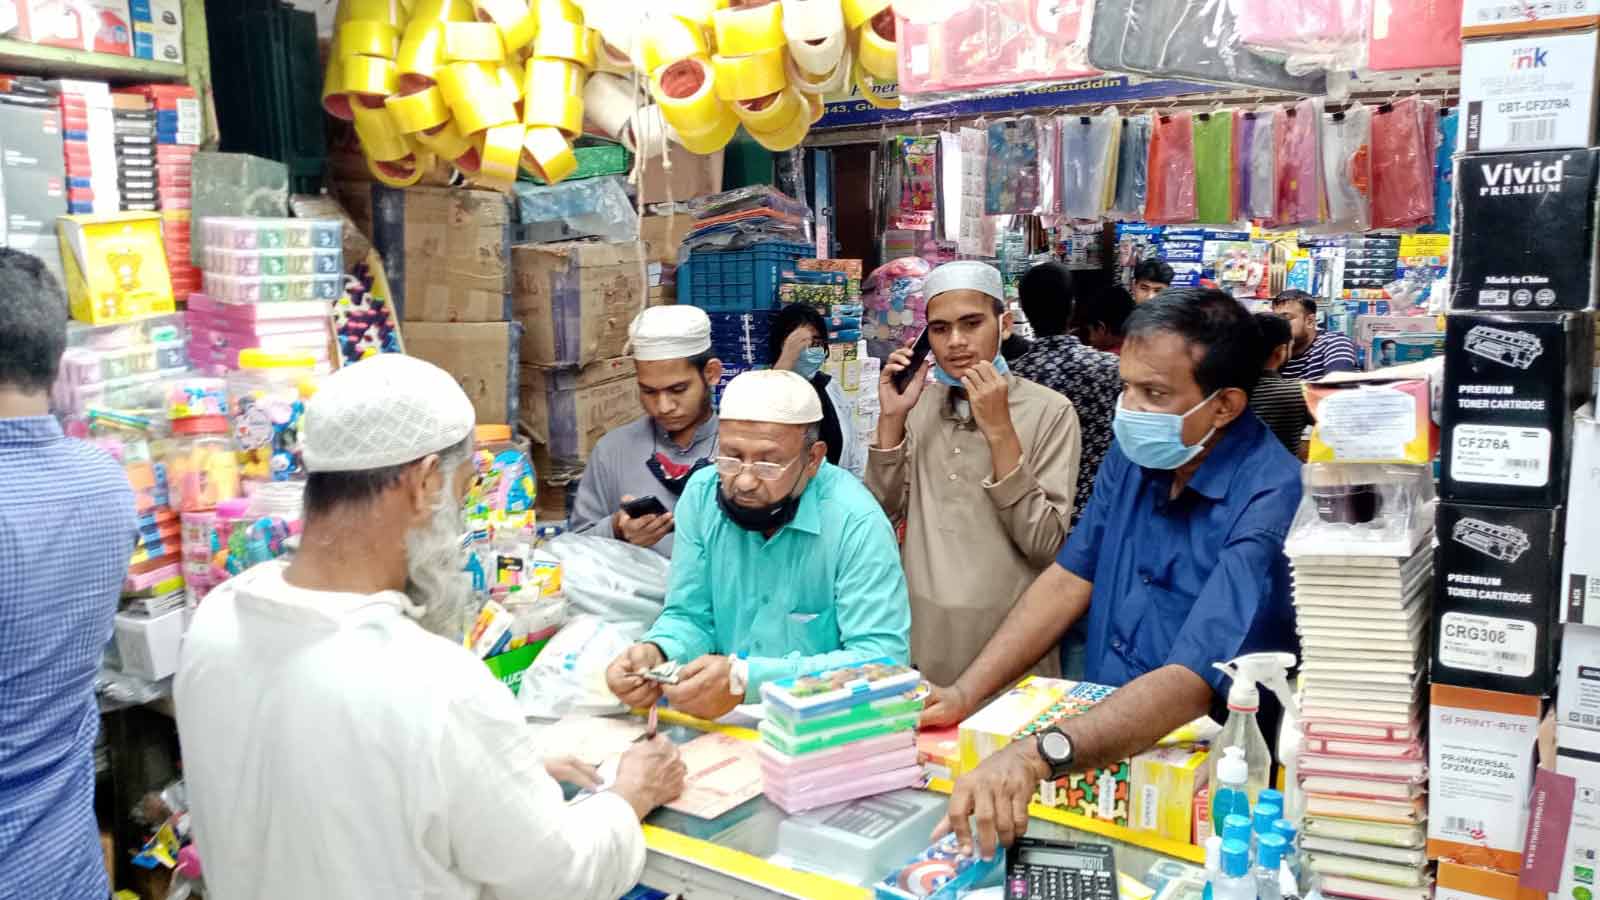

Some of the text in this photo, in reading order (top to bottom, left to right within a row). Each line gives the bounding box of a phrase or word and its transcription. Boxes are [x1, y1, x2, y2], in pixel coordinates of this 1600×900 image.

[1481, 160, 1563, 186] Vivid
[1480, 184, 1561, 196] PREMIUM
[1485, 275, 1549, 284] Made in China
[1458, 385, 1514, 395] PREMIUM
[1458, 398, 1545, 410] TONER CARTRIDGE
[1447, 574, 1501, 586] PREMIUM
[1447, 587, 1532, 603] TONER CARTRIDGE
[1444, 623, 1507, 644] CRG308
